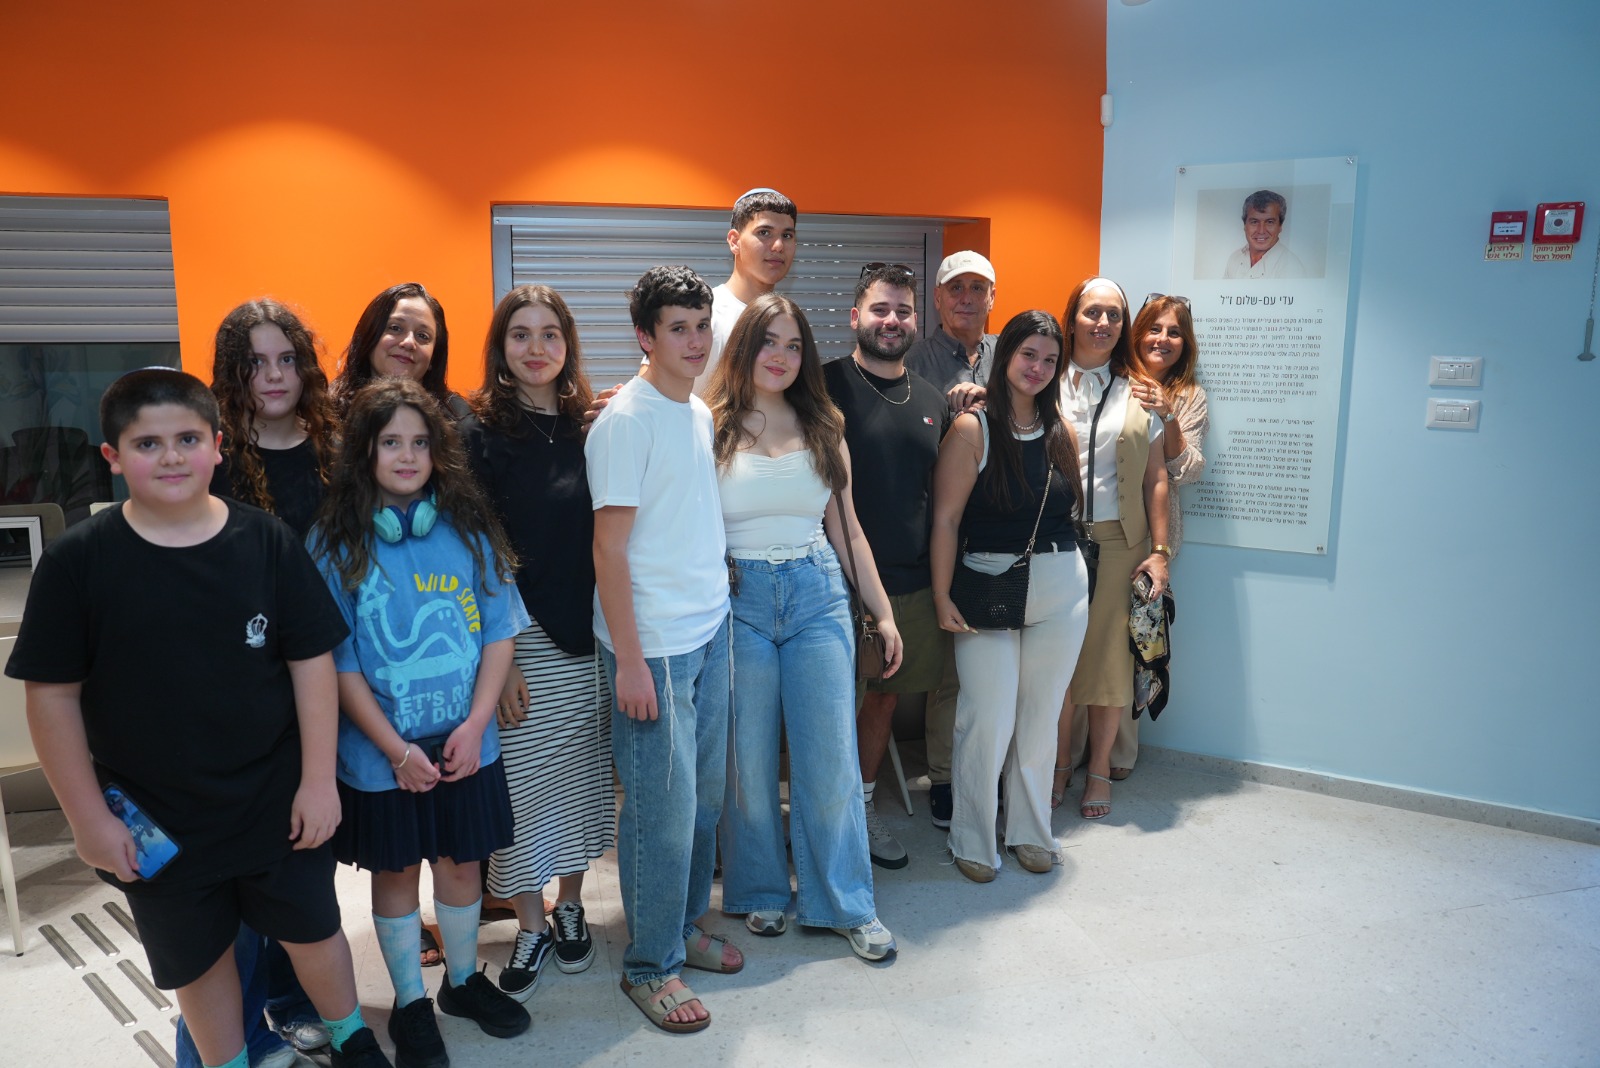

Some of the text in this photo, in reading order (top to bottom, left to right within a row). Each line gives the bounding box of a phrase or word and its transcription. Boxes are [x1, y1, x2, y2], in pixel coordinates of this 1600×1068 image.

[1220, 294, 1294, 306] עדי עם-שלום ז"ל
[414, 573, 458, 592] WILD
[396, 690, 444, 716] ET'S
[394, 710, 424, 733] MY
